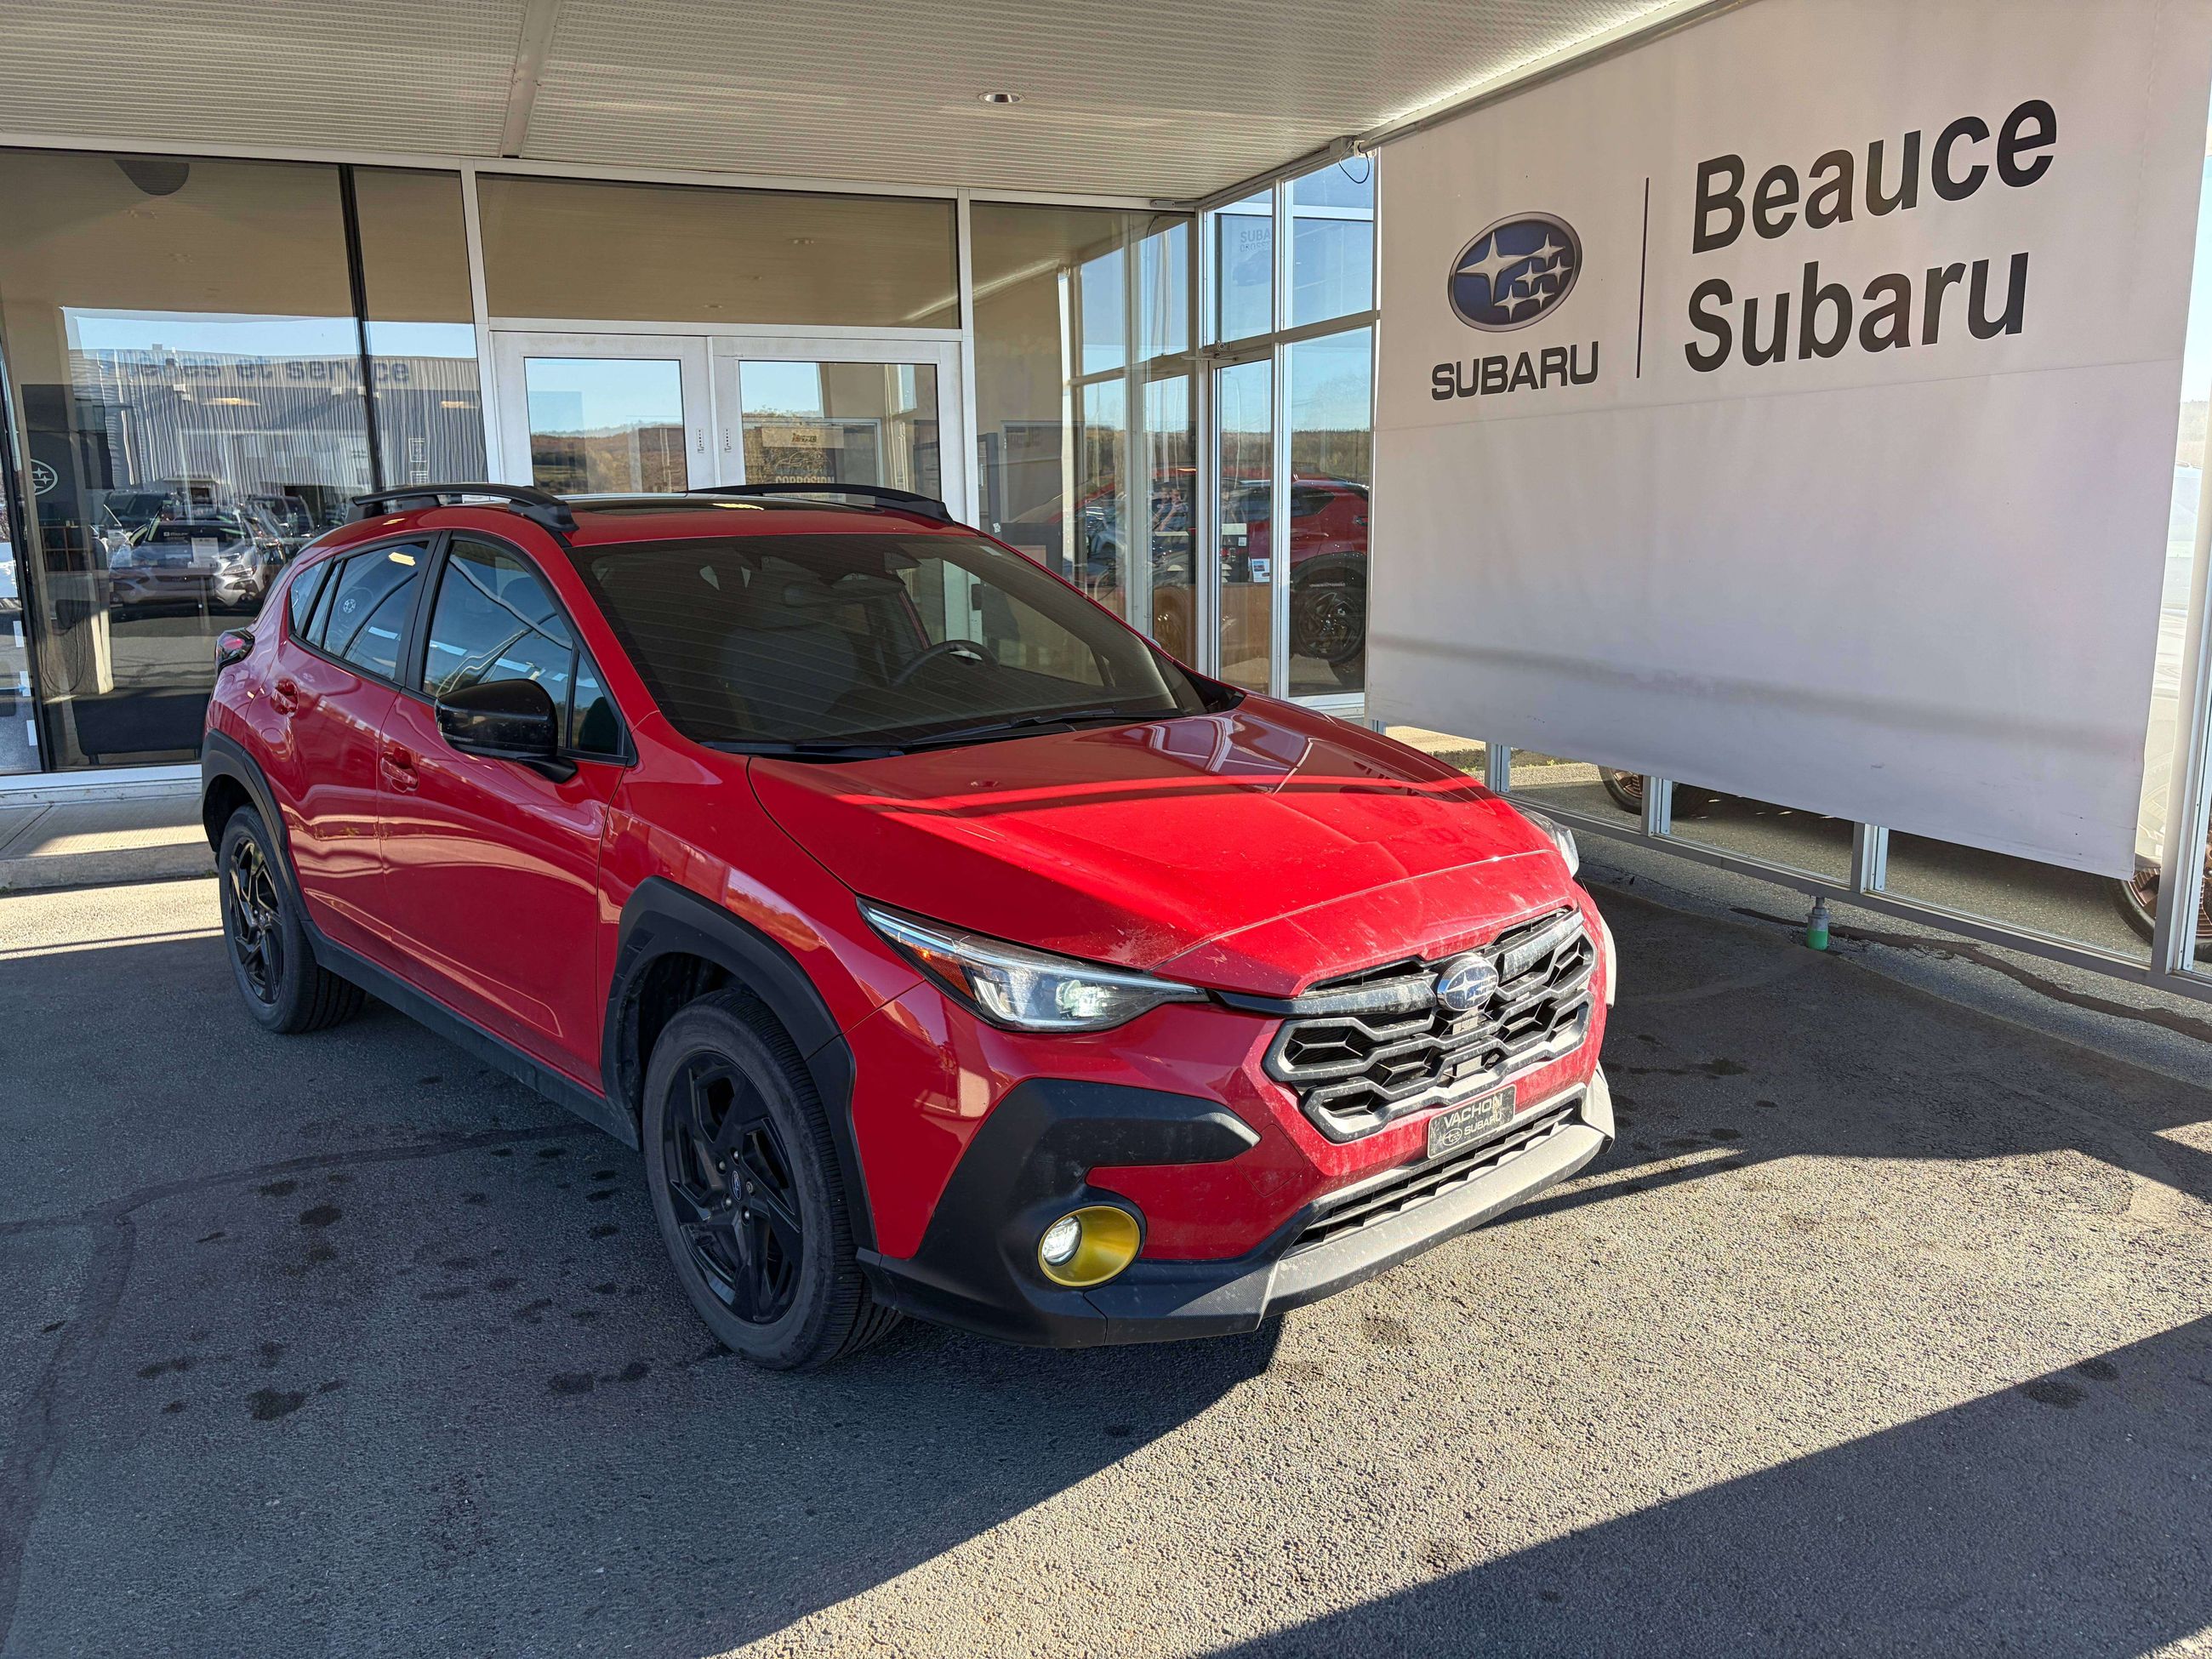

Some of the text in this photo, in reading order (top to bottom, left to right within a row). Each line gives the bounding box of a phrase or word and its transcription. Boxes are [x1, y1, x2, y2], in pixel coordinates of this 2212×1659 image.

[1692, 99, 2057, 254] Beauce
[1685, 252, 2029, 373] Subaru
[286, 360, 410, 382] servce
[1431, 340, 1599, 401] SUBARU
[1444, 1093, 1503, 1129] VACHON
[1464, 1111, 1502, 1135] SUBARU
